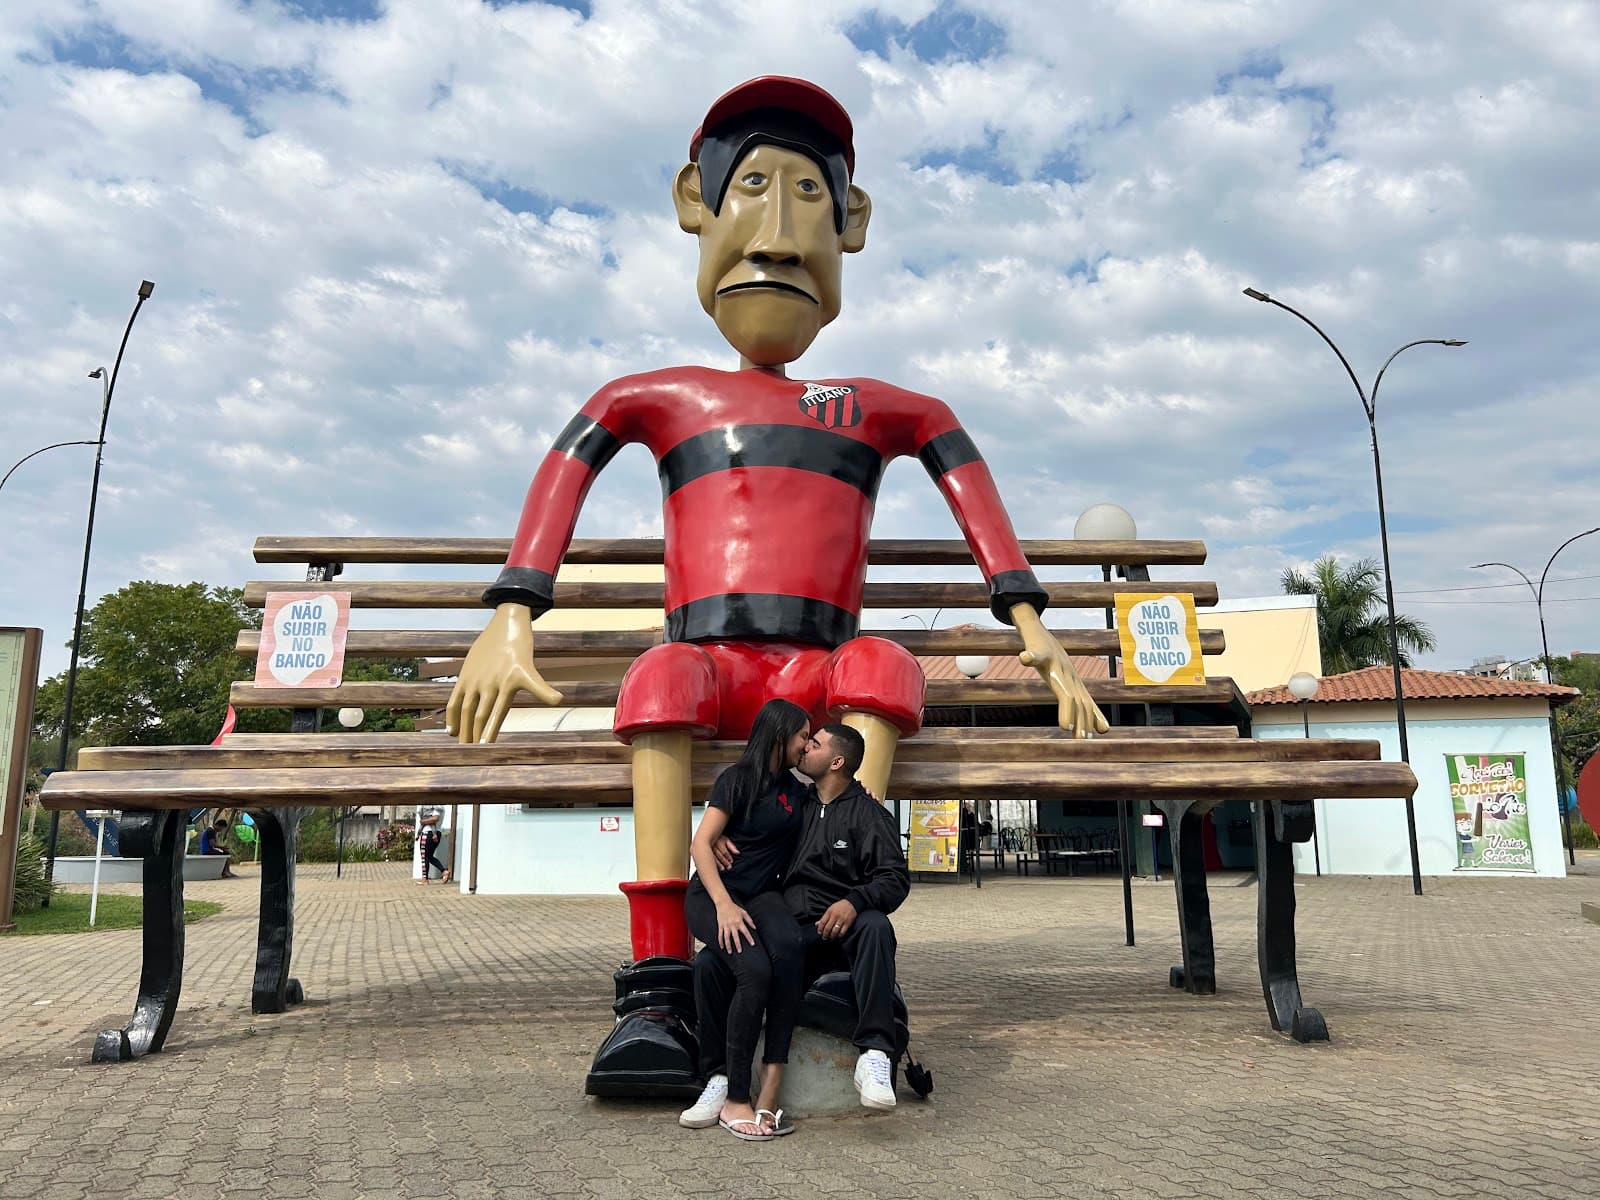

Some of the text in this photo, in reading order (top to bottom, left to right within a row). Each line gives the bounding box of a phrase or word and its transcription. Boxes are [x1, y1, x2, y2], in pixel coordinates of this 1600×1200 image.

[803, 386, 852, 407] ITUANO
[291, 602, 323, 620] NÃO
[1141, 602, 1171, 620] NÃO
[282, 621, 327, 636] SUBIR
[1137, 621, 1179, 636] SUBIR
[291, 637, 313, 652] NO
[1150, 636, 1170, 650] NO
[275, 653, 326, 668] BANCO
[1139, 651, 1186, 666] BANCO
[1450, 776, 1526, 797] SORVETÃO
